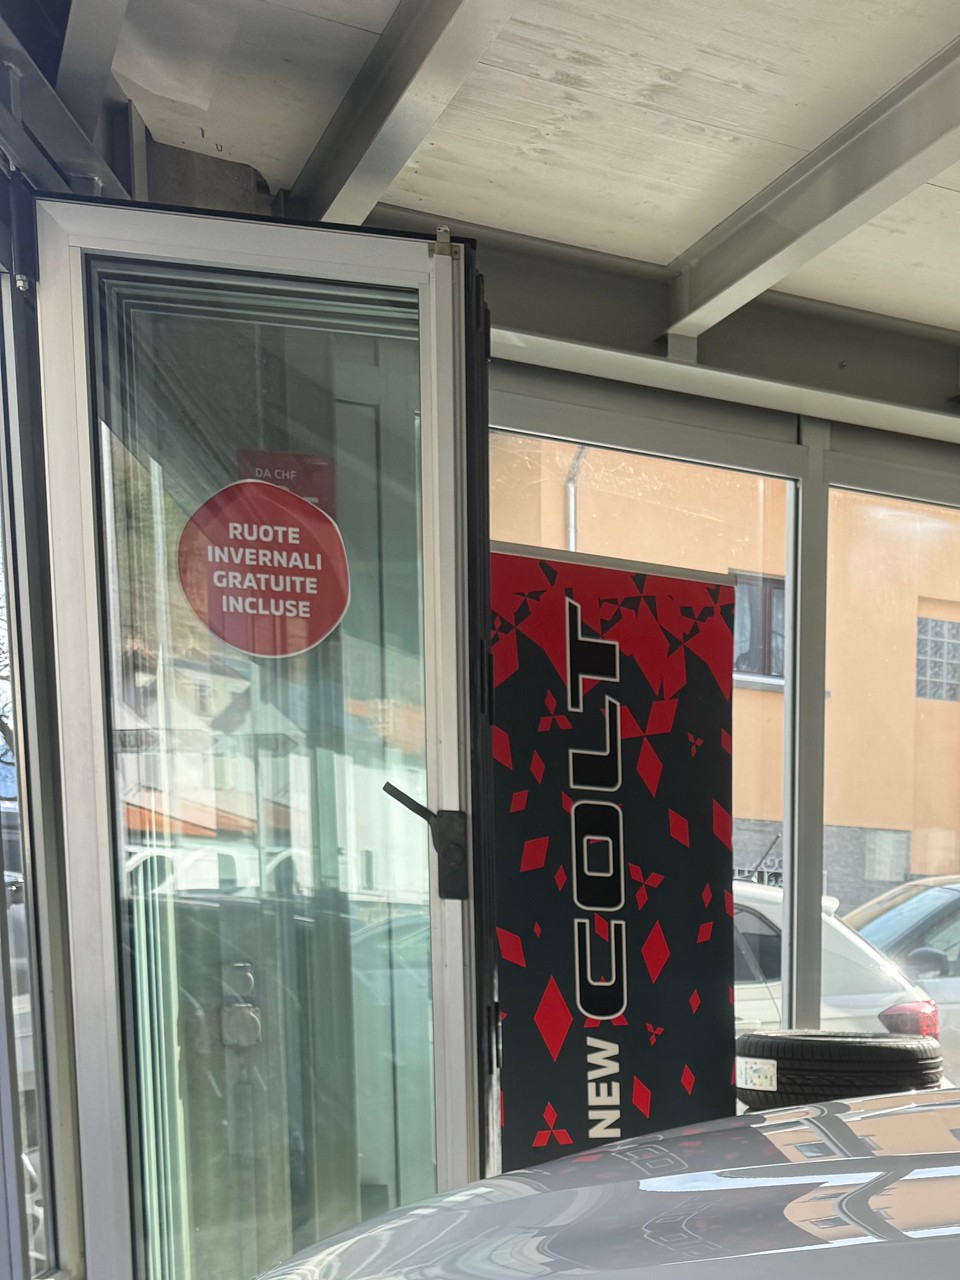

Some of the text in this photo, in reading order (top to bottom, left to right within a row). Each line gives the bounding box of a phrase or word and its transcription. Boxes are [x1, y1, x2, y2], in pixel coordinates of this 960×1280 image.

[255, 467, 297, 480] DA CHF
[228, 522, 300, 545] RUOTE
[207, 545, 322, 570] INVERNALI
[213, 570, 318, 594] GRATUITE
[222, 595, 311, 618] INCLUSE
[565, 596, 627, 1139] NEW COLT
